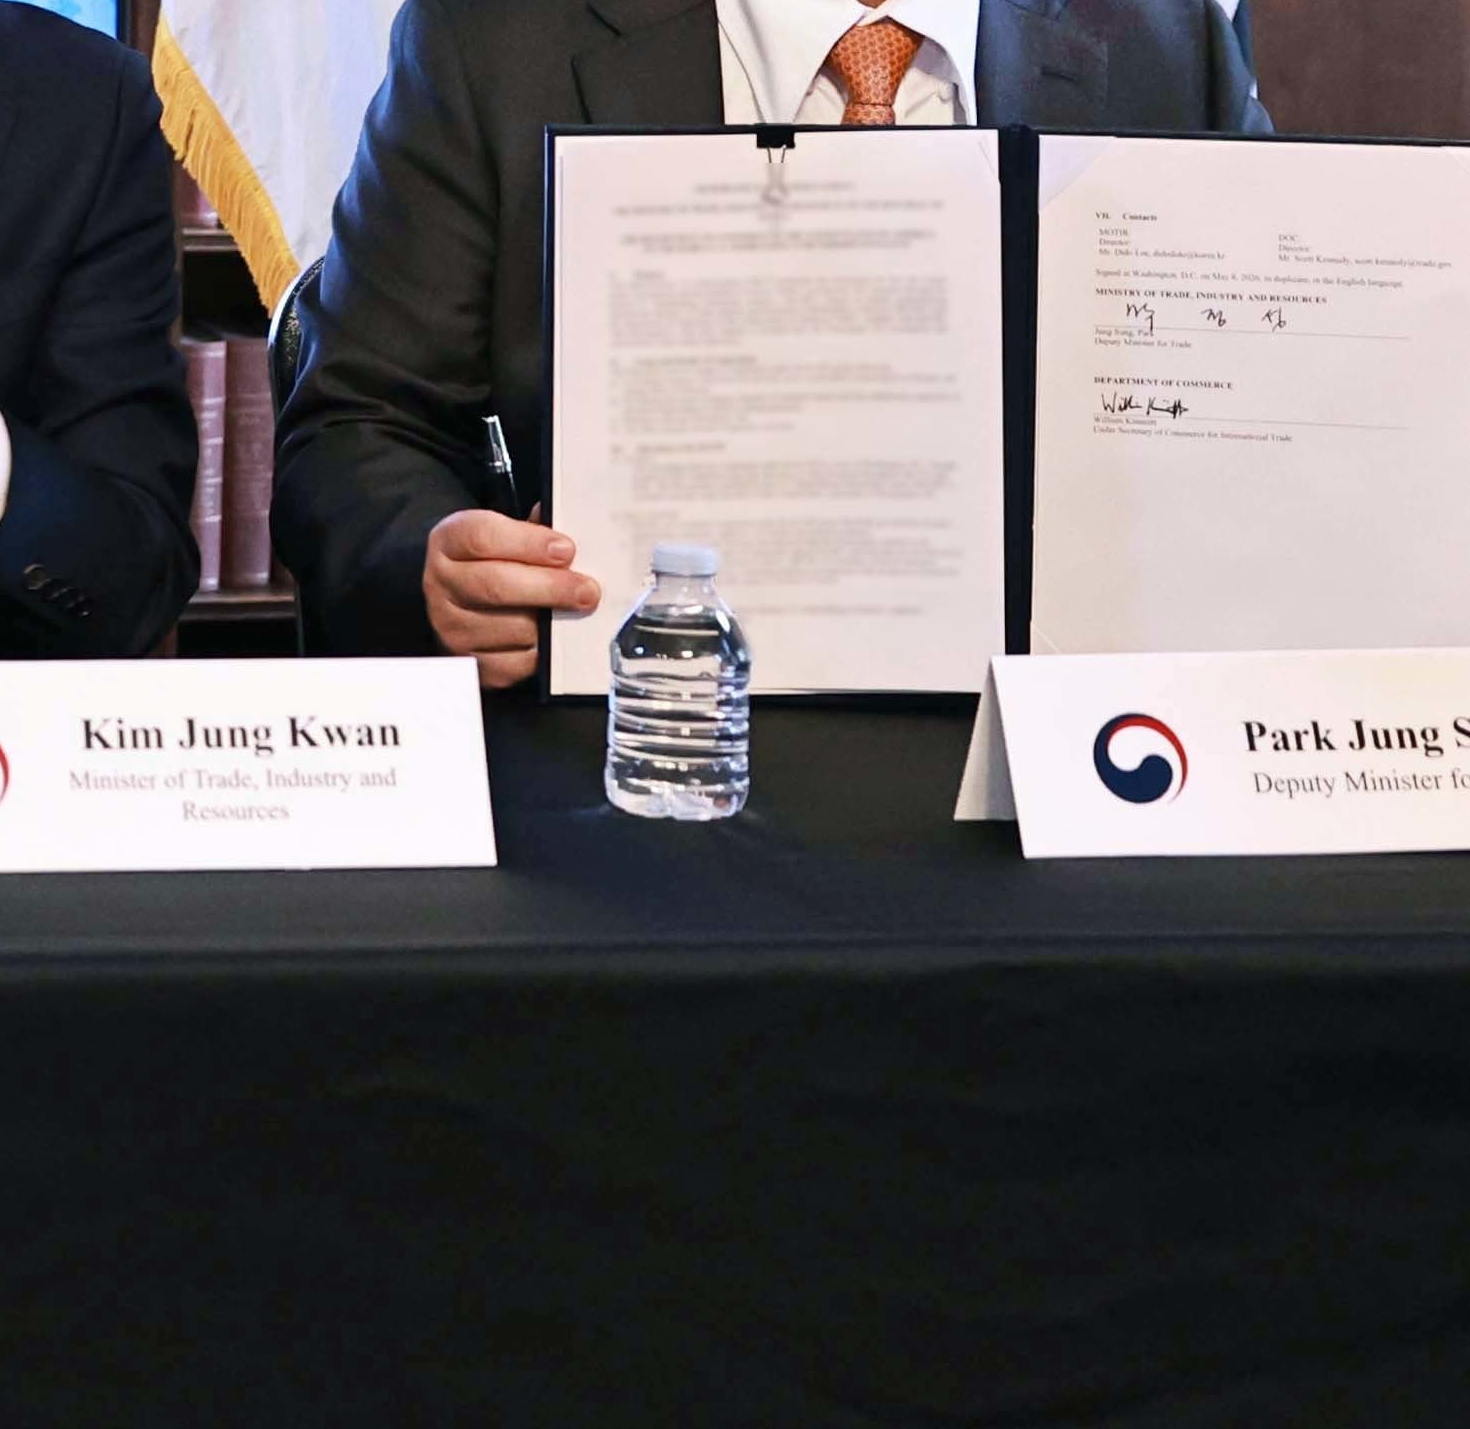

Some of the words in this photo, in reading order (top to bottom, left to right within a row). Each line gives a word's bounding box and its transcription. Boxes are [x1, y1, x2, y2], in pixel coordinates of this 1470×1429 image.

[1096, 288, 1141, 298] MINISTRY
[1144, 289, 1157, 298] OF
[1197, 291, 1243, 301] INDUSTRY
[1248, 293, 1267, 302] AND
[1270, 294, 1328, 304] RESOURCES
[1094, 376, 1158, 387] DEPARTMENT
[1161, 379, 1174, 387] OF
[1176, 380, 1234, 389] COMMERCE
[81, 718, 164, 752] Kim
[178, 717, 273, 756] Jung
[289, 716, 401, 750] Kwan
[1244, 720, 1336, 752] Park
[1350, 718, 1445, 757] Jung
[70, 770, 157, 791] Minister
[165, 769, 189, 790] of
[194, 769, 260, 793] Trade,
[266, 767, 351, 793] Industry
[359, 766, 397, 788] and
[1254, 770, 1335, 798] Deputy
[1345, 770, 1442, 794] Minister
[1451, 767, 1470, 789] fo
[182, 800, 290, 822] Resources
